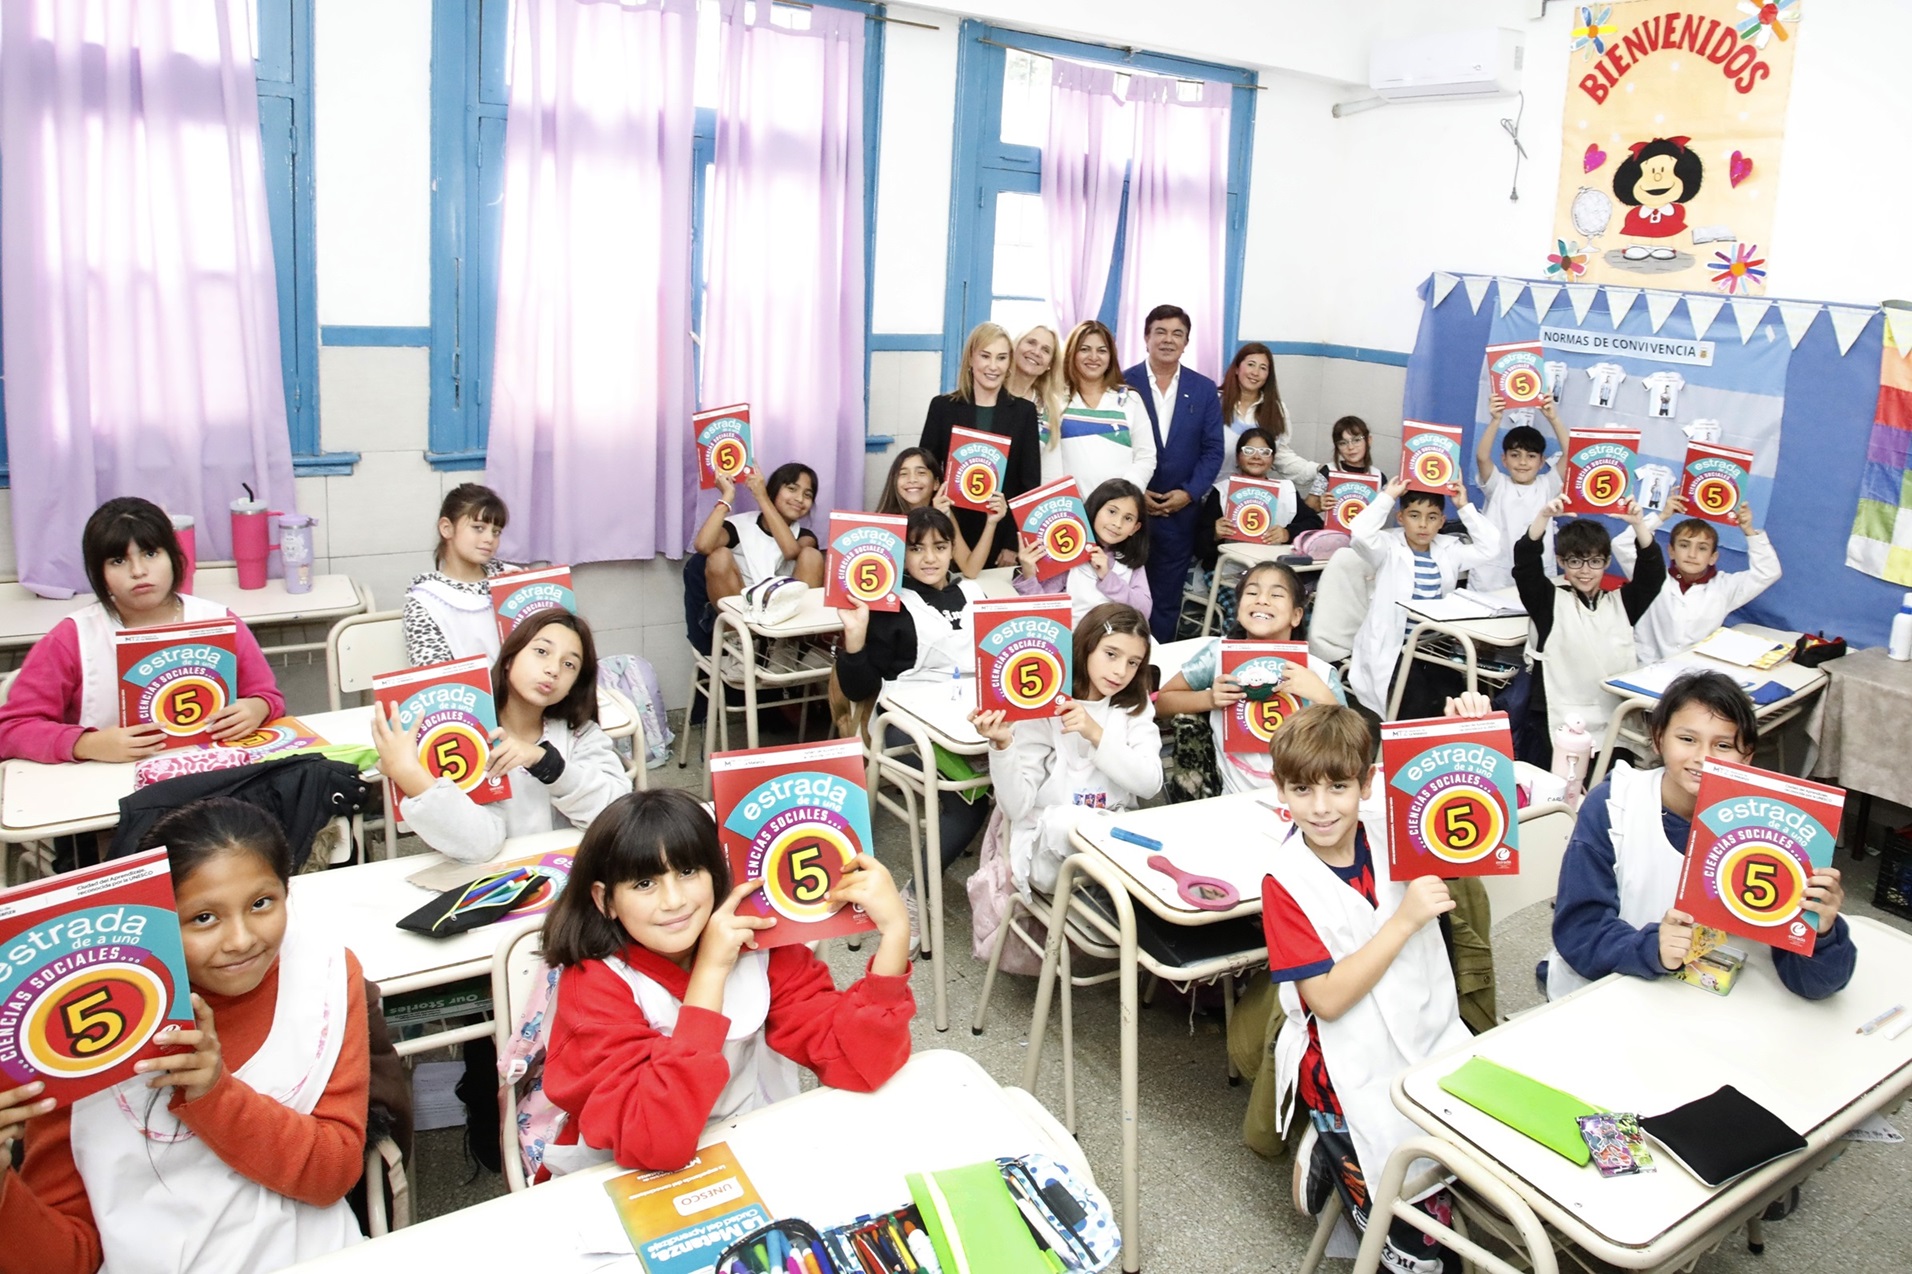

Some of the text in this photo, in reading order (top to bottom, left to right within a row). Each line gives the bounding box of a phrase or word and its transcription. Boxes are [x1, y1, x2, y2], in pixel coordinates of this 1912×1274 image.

[1578, 12, 1771, 105] BIENVENIDOS
[1543, 331, 1697, 358] NORMAS DE CONVIVENCIA
[1516, 376, 1530, 395] 5
[703, 420, 741, 439] estrada
[720, 447, 735, 471] 5
[960, 444, 1000, 462] estrada
[1580, 444, 1629, 460] estrada
[1426, 460, 1440, 480] 5
[1694, 459, 1741, 477] estrada
[971, 473, 984, 496] 5
[1595, 475, 1612, 499] 5
[1707, 486, 1723, 508] 5
[1029, 496, 1073, 526] estrada
[1246, 512, 1259, 530] 5
[1347, 506, 1358, 523] 5
[841, 529, 896, 548] estrada
[1054, 527, 1075, 554] 5
[860, 564, 879, 592] 5
[507, 585, 563, 610] estrada
[992, 620, 1059, 645] estrada
[139, 647, 221, 676] estrada
[1019, 661, 1044, 698] 5
[173, 689, 203, 726] 5
[400, 686, 477, 724] estrada
[1262, 700, 1285, 733] 5
[434, 738, 469, 781] 5
[1407, 747, 1497, 781] estrada
[1454, 762, 1465, 771] de
[1476, 767, 1492, 779] uno
[744, 777, 847, 821] estrada
[797, 796, 809, 806] de
[822, 801, 842, 812] uno
[1444, 803, 1479, 849] 5
[1717, 798, 1817, 842] estrada
[1768, 819, 1808, 847] de a uno
[748, 830, 772, 881] IENCIAS
[788, 843, 830, 904] 5
[1742, 860, 1779, 911] 5
[0, 907, 147, 983] estrada
[72, 935, 140, 950] de a uno
[389, 999, 444, 1014] Stories
[449, 994, 478, 1004] Our
[60, 985, 126, 1058] 5
[681, 1183, 733, 1206] UNESCO
[723, 1208, 759, 1225] Ciudad
